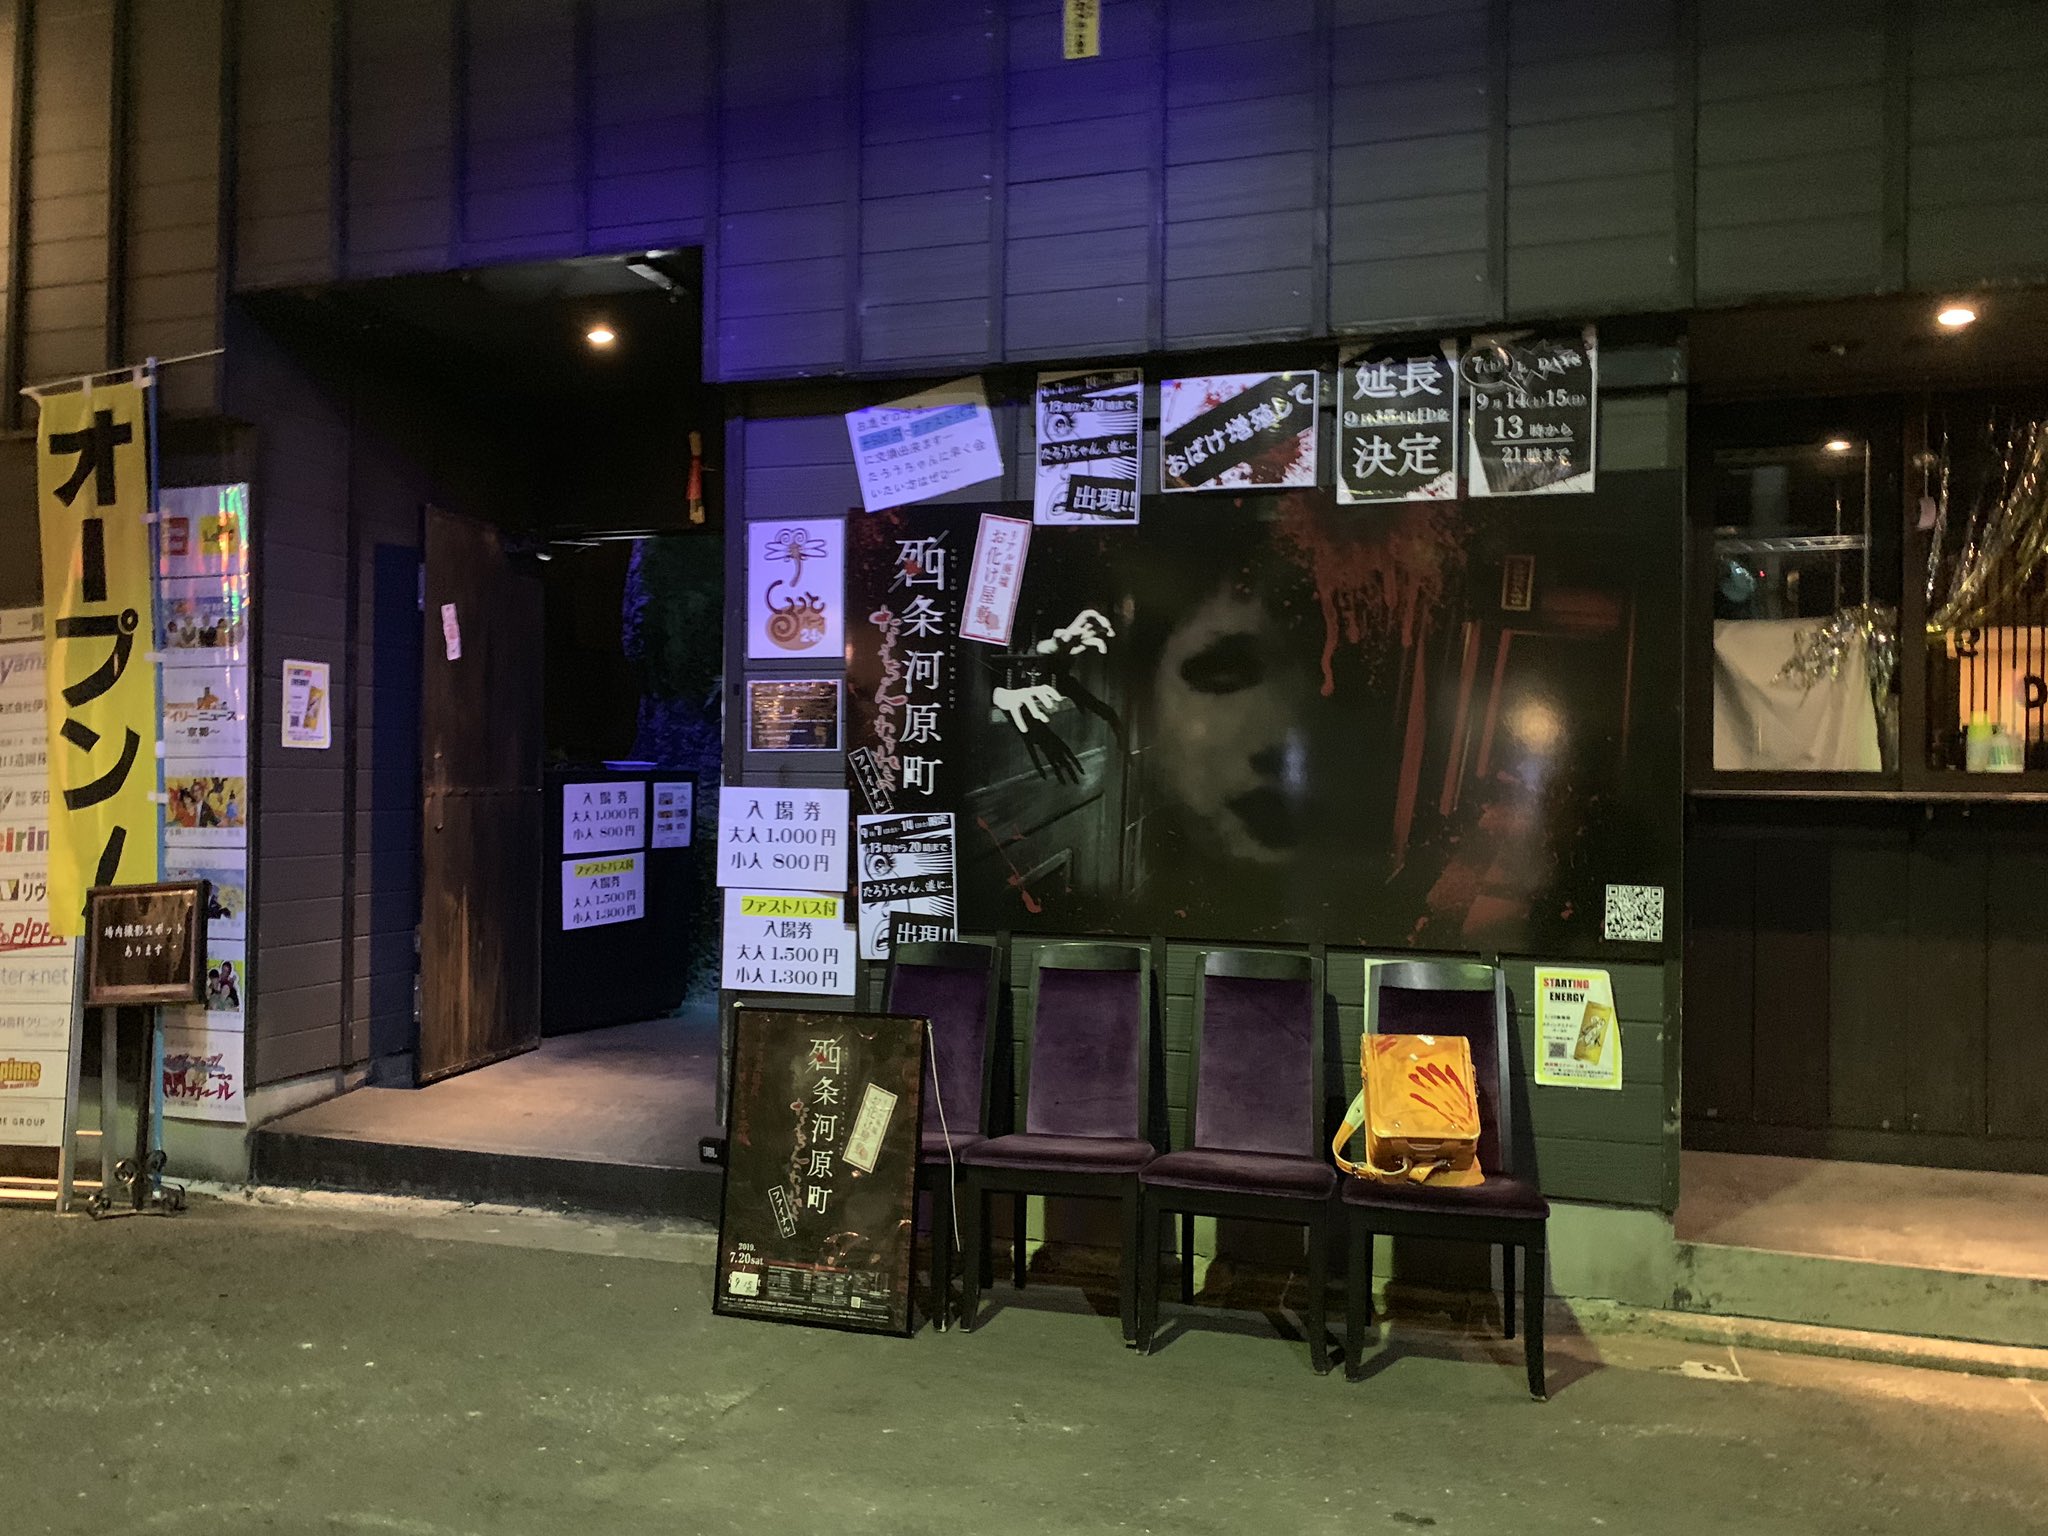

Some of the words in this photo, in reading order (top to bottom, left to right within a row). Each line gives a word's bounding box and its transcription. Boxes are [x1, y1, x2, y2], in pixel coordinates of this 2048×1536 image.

[1353, 355, 1443, 400] 延長
[1352, 432, 1442, 478] 決定
[124, 943, 163, 958] あります
[1543, 977, 1589, 989] STARTING
[1550, 991, 1585, 1003] ENERGY
[13, 1117, 45, 1126] GROUP
